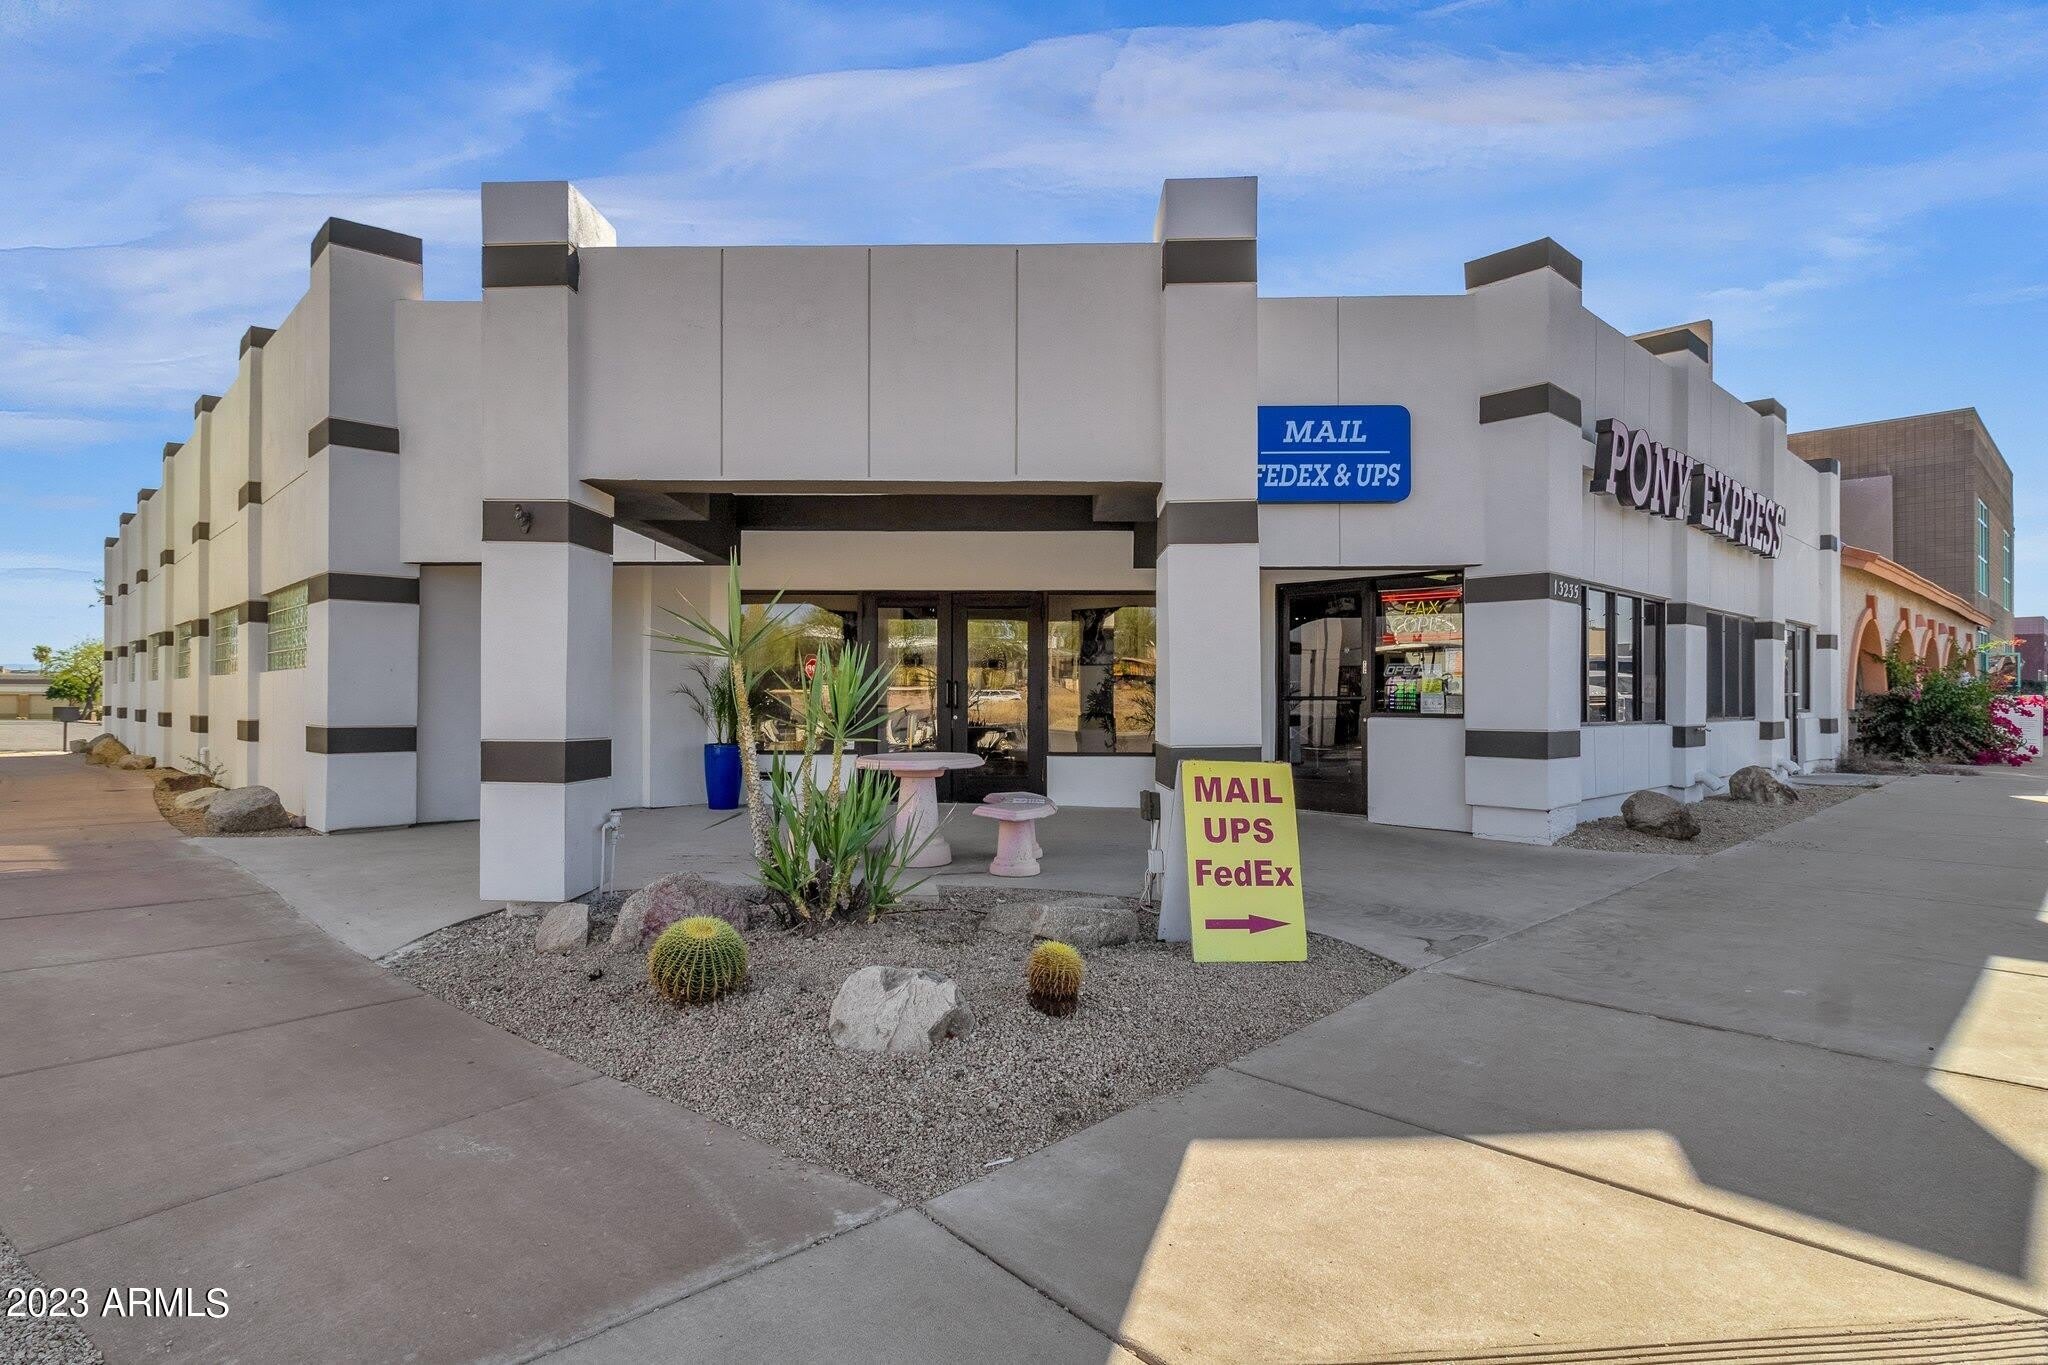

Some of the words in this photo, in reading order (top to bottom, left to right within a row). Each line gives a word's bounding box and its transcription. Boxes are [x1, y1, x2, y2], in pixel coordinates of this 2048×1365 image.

[1283, 420, 1367, 443] MAIL
[1334, 463, 1351, 487] &
[1356, 463, 1401, 487] UPS
[1603, 418, 1695, 520] PONY
[1699, 463, 1785, 559] EXPRESS
[1554, 579, 1579, 599] 13235
[1404, 600, 1440, 616] FAX
[1385, 664, 1421, 676] OPEN
[1194, 776, 1283, 803] MAIL
[1203, 817, 1274, 844] UPS
[1195, 859, 1294, 887] FedEx
